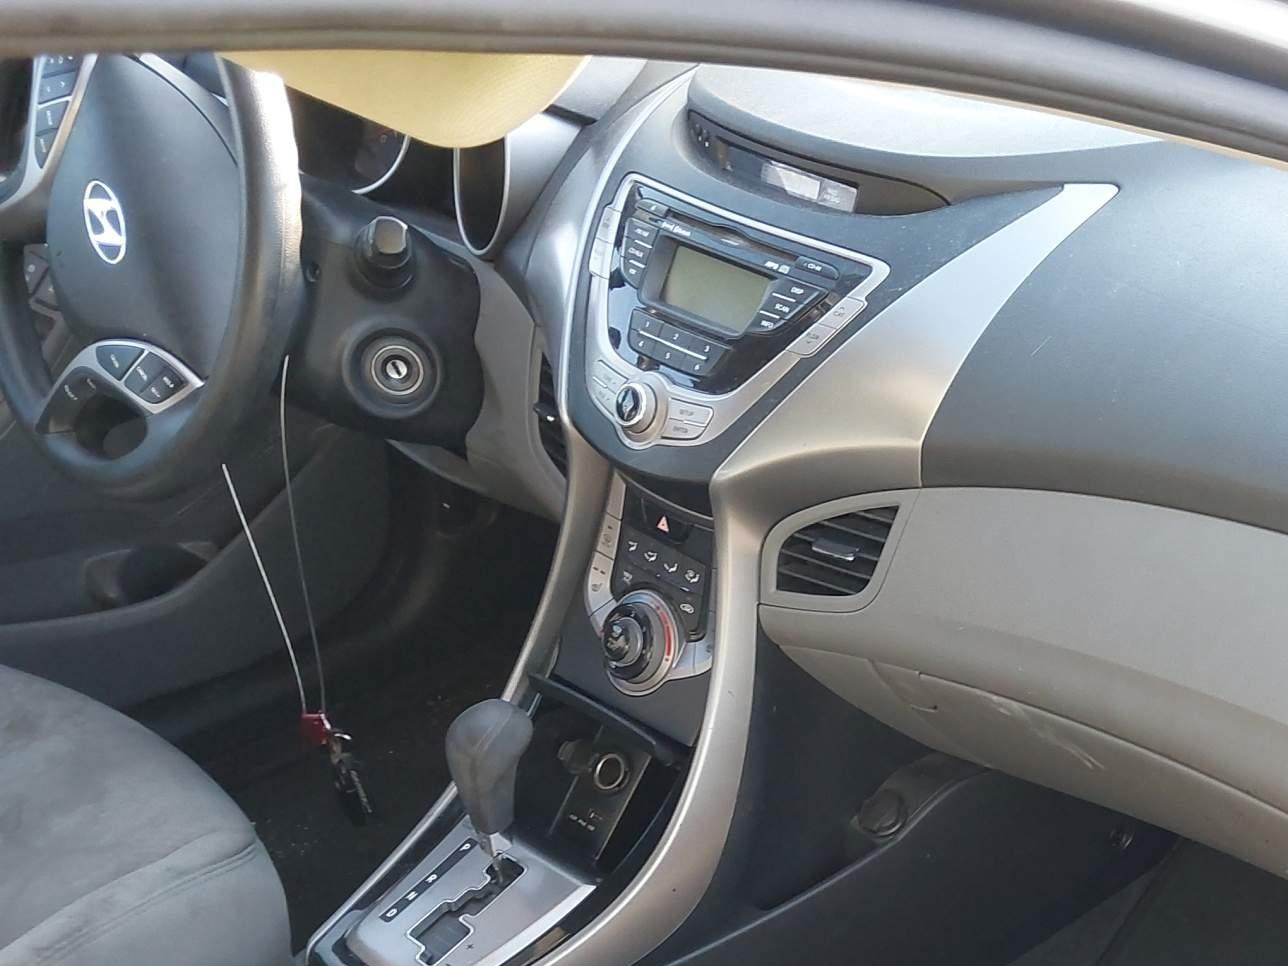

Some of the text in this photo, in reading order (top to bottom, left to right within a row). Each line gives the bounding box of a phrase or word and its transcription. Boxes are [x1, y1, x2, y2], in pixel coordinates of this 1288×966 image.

[460, 843, 472, 851] P
[425, 873, 438, 884] R
[385, 908, 398, 918] D
